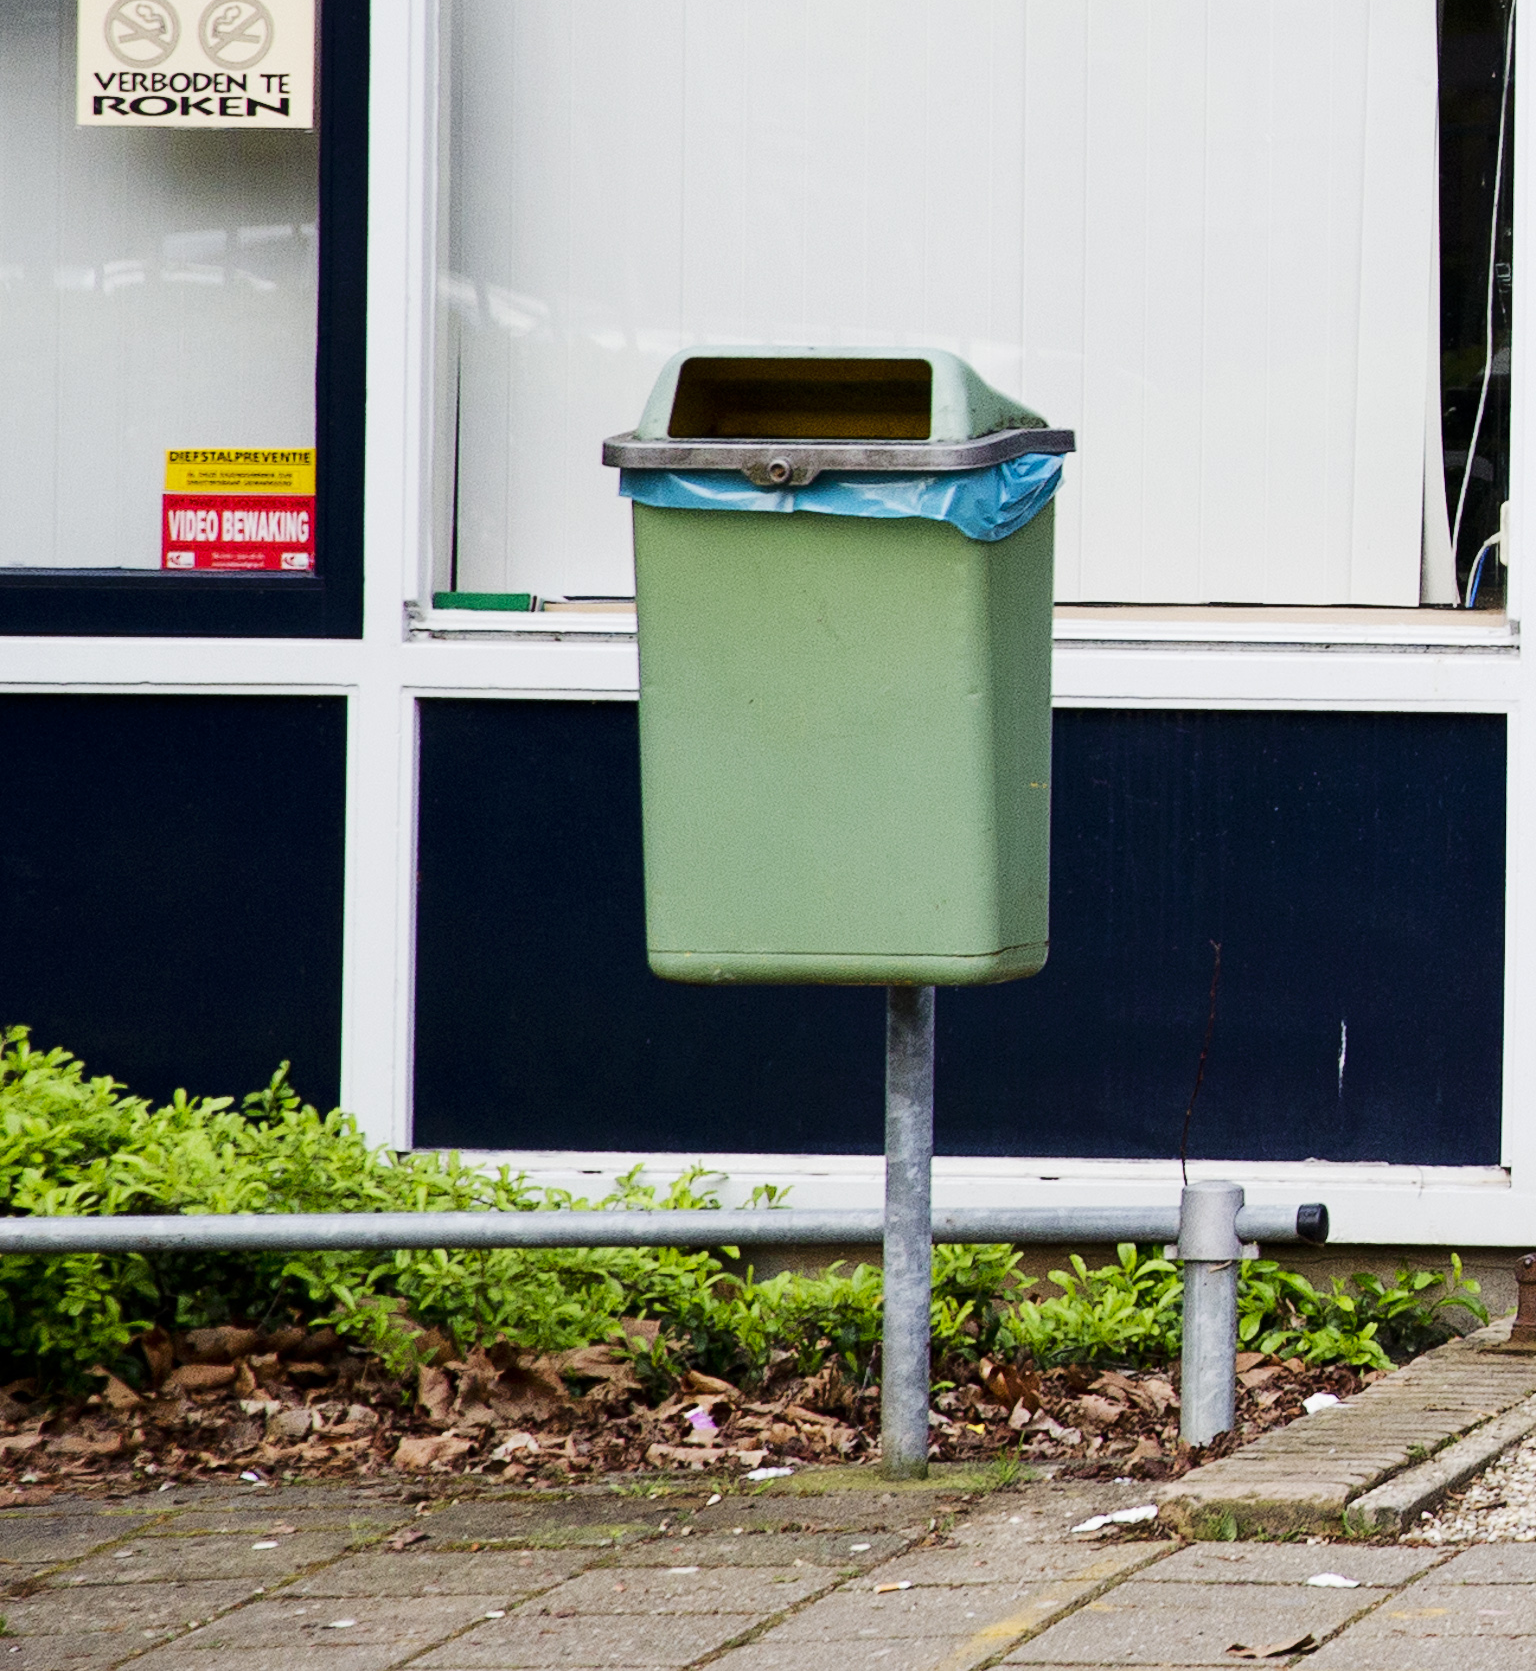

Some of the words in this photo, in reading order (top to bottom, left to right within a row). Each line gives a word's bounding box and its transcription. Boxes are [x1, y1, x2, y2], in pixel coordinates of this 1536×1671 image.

[94, 72, 247, 93] VERBODEN
[260, 73, 291, 94] TE
[92, 95, 290, 117] ROKEN
[169, 451, 311, 463] DIEFSTALPREVENTIE
[167, 510, 219, 542] VIDEO
[221, 510, 310, 543] BEWAKING
